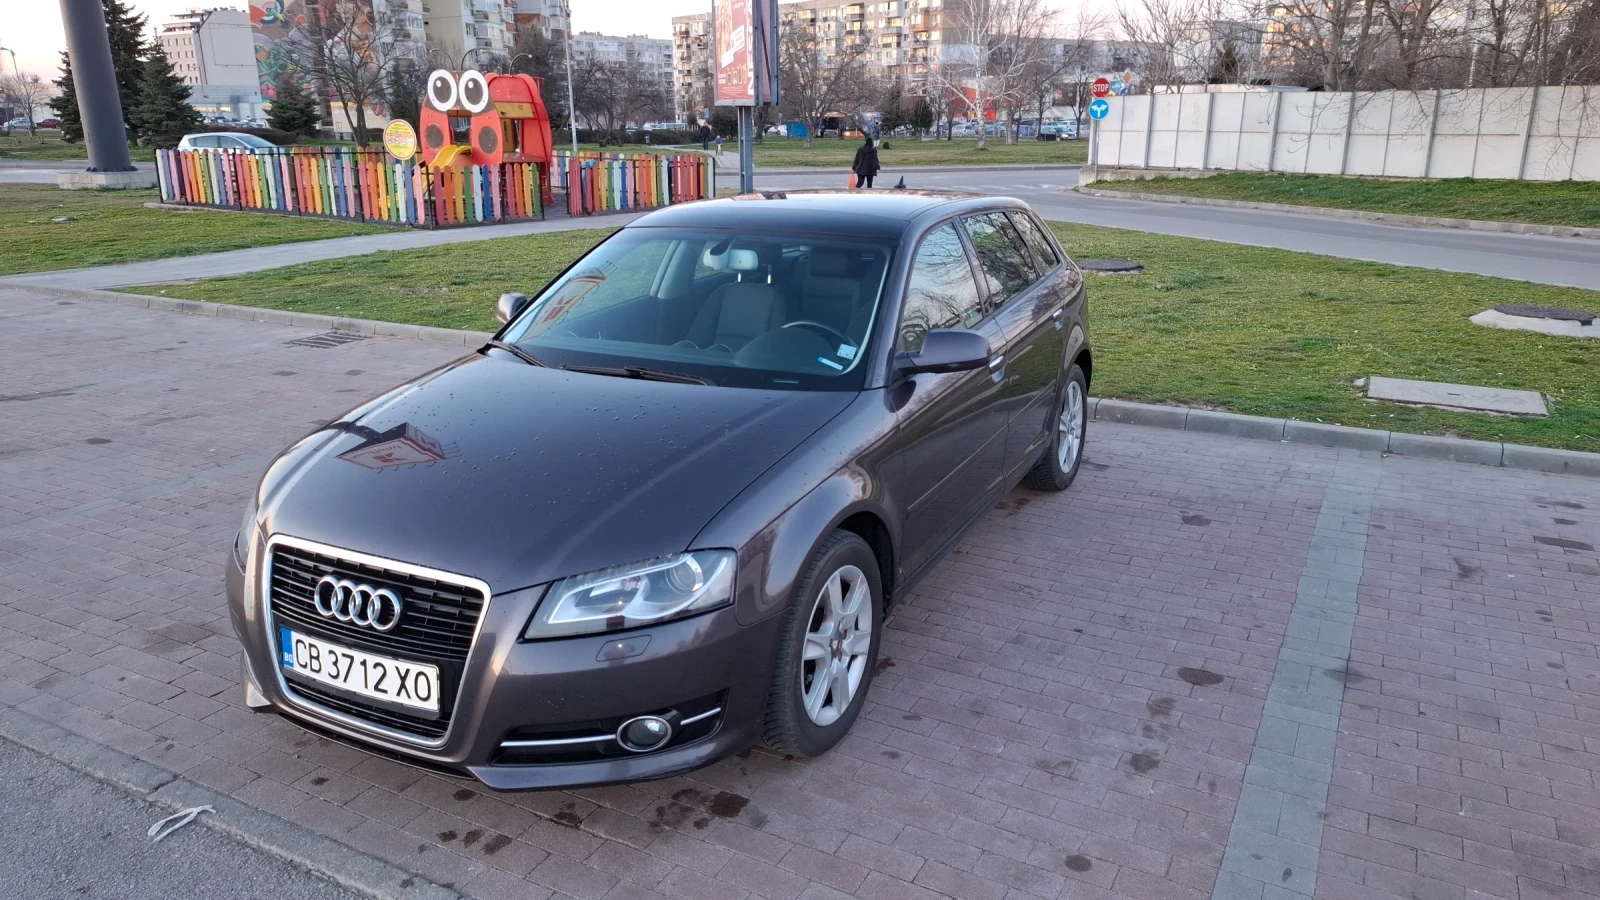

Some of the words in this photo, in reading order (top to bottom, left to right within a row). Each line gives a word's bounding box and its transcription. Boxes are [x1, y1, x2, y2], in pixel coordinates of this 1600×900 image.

[1094, 84, 1110, 93] STOP
[284, 652, 294, 663] BG
[295, 638, 322, 674] CB
[328, 649, 389, 694] 3712
[395, 666, 432, 702] XO
